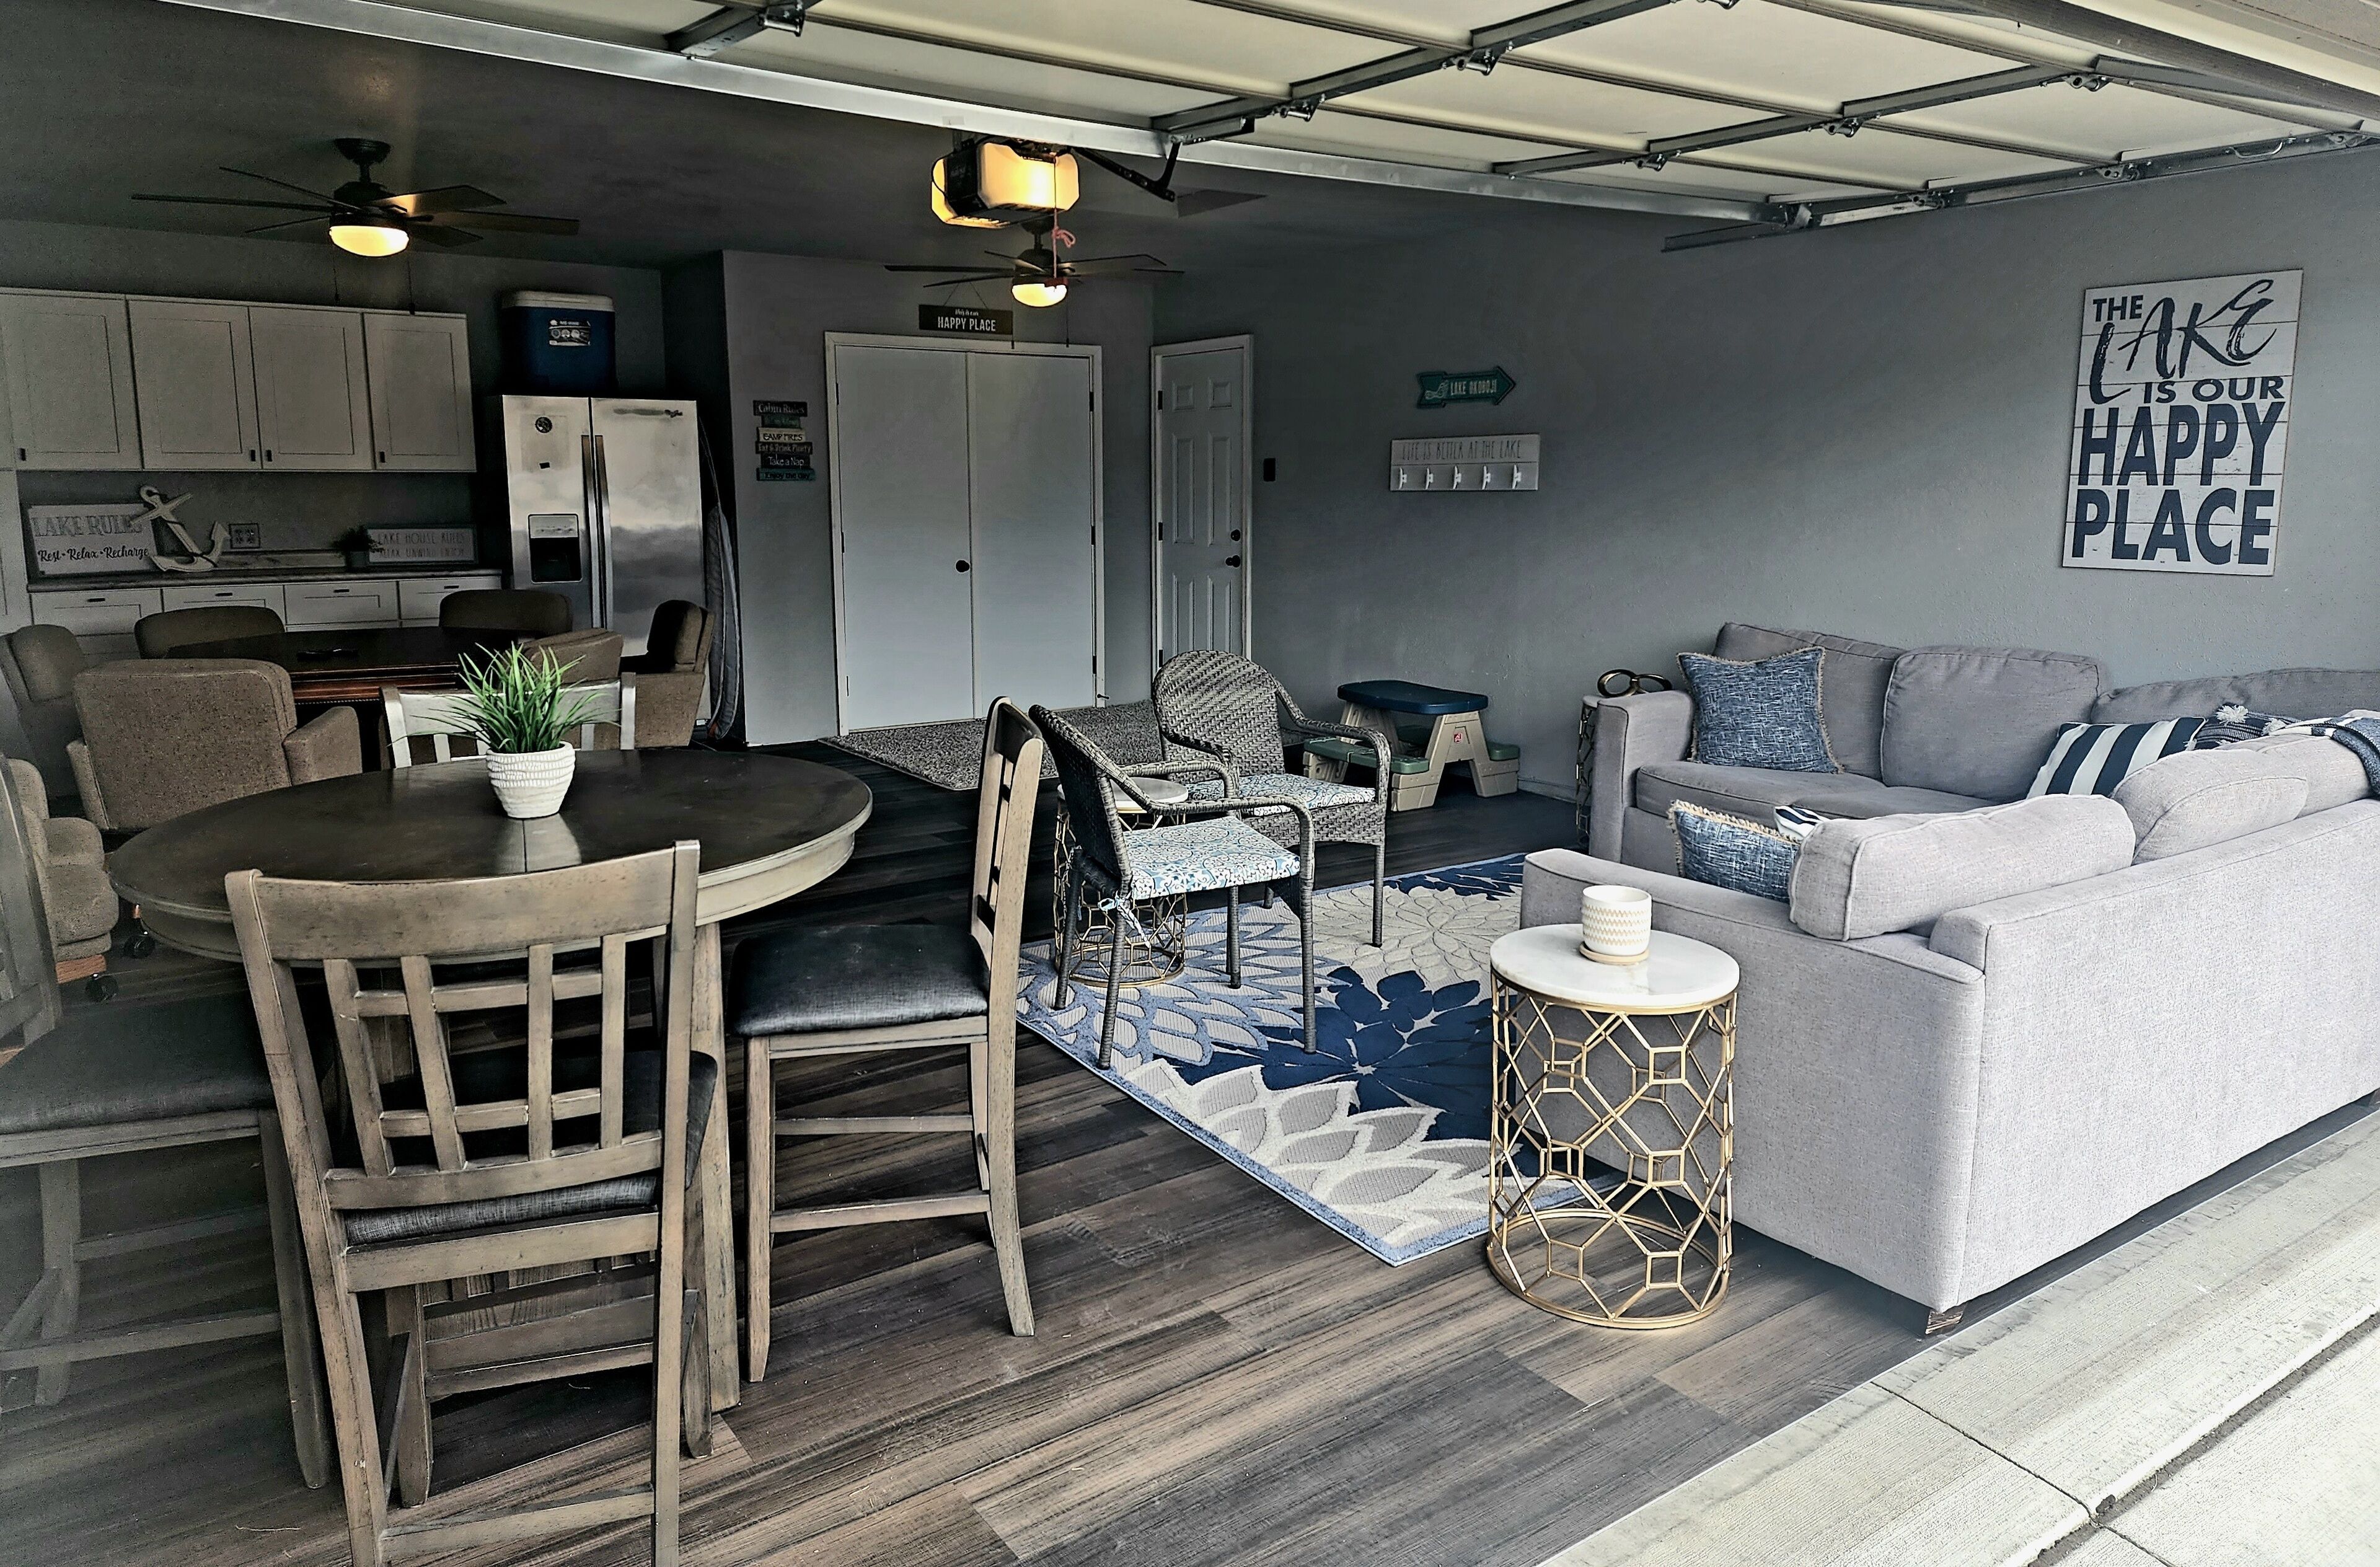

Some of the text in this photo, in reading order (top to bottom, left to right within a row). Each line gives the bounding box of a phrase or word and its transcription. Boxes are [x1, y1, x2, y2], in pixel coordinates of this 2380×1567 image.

[2093, 294, 2143, 322] THE
[938, 316, 996, 332] HAPPY PLACE
[2089, 279, 2277, 405] LAKE
[1450, 381, 1466, 395] LAKE
[2143, 375, 2285, 404] IS OUR
[759, 403, 782, 413] Cabin
[1403, 440, 1520, 460] LIFE IS BETTER AT THE LAKE
[2078, 402, 2286, 486] HAPPY
[768, 454, 784, 465] Take
[790, 457, 804, 469] Nap
[31, 517, 82, 537] LAKE
[2072, 488, 2275, 565] PLACE
[377, 533, 399, 544] LAKE
[405, 532, 435, 544] HOUSE
[38, 545, 148, 562] Rest Relax Recharge
